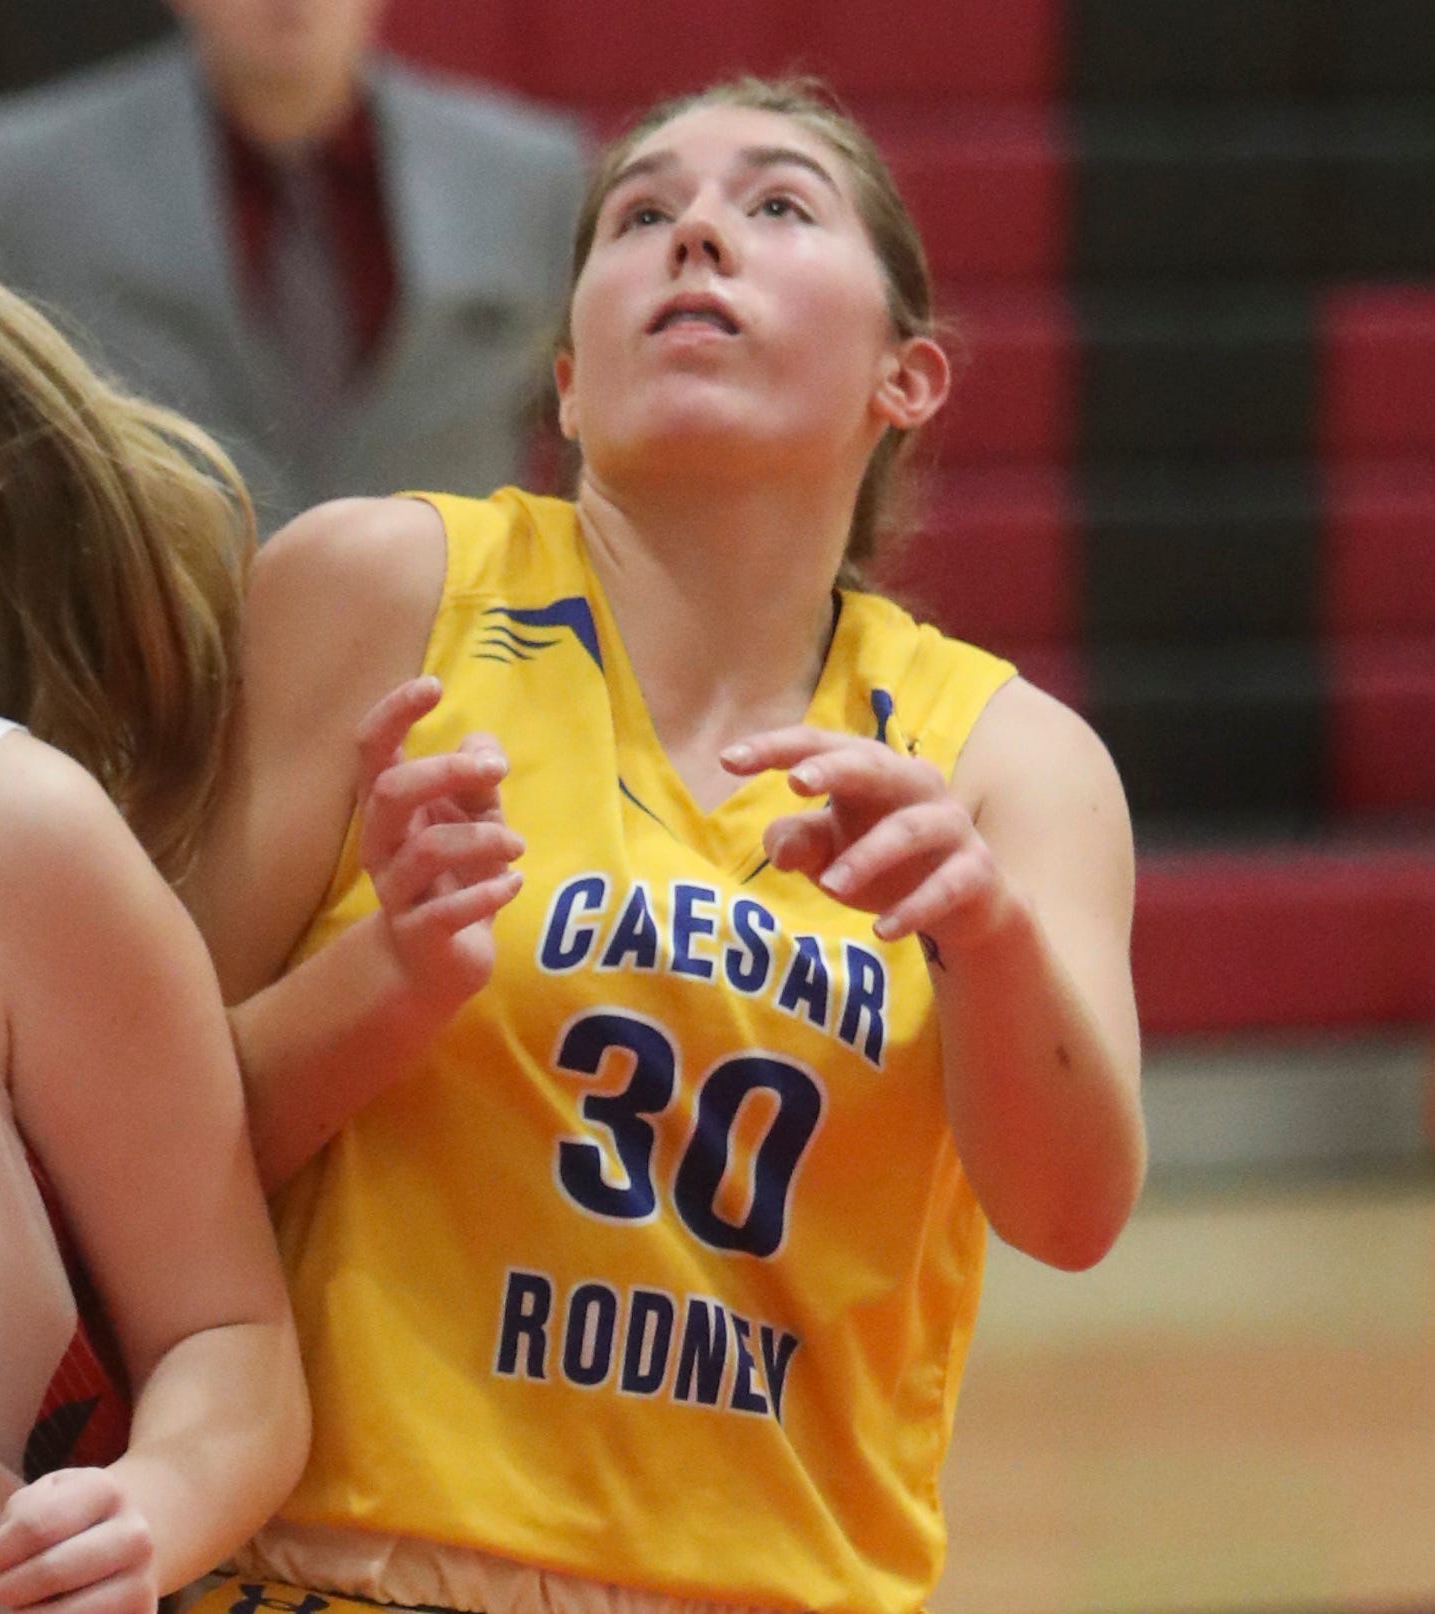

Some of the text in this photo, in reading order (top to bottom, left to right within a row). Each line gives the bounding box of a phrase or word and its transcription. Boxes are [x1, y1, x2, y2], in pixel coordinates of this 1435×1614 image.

[538, 875, 887, 1069] CAESAR
[553, 1009, 826, 1260] 30
[495, 1268, 802, 1426] RODNEY
